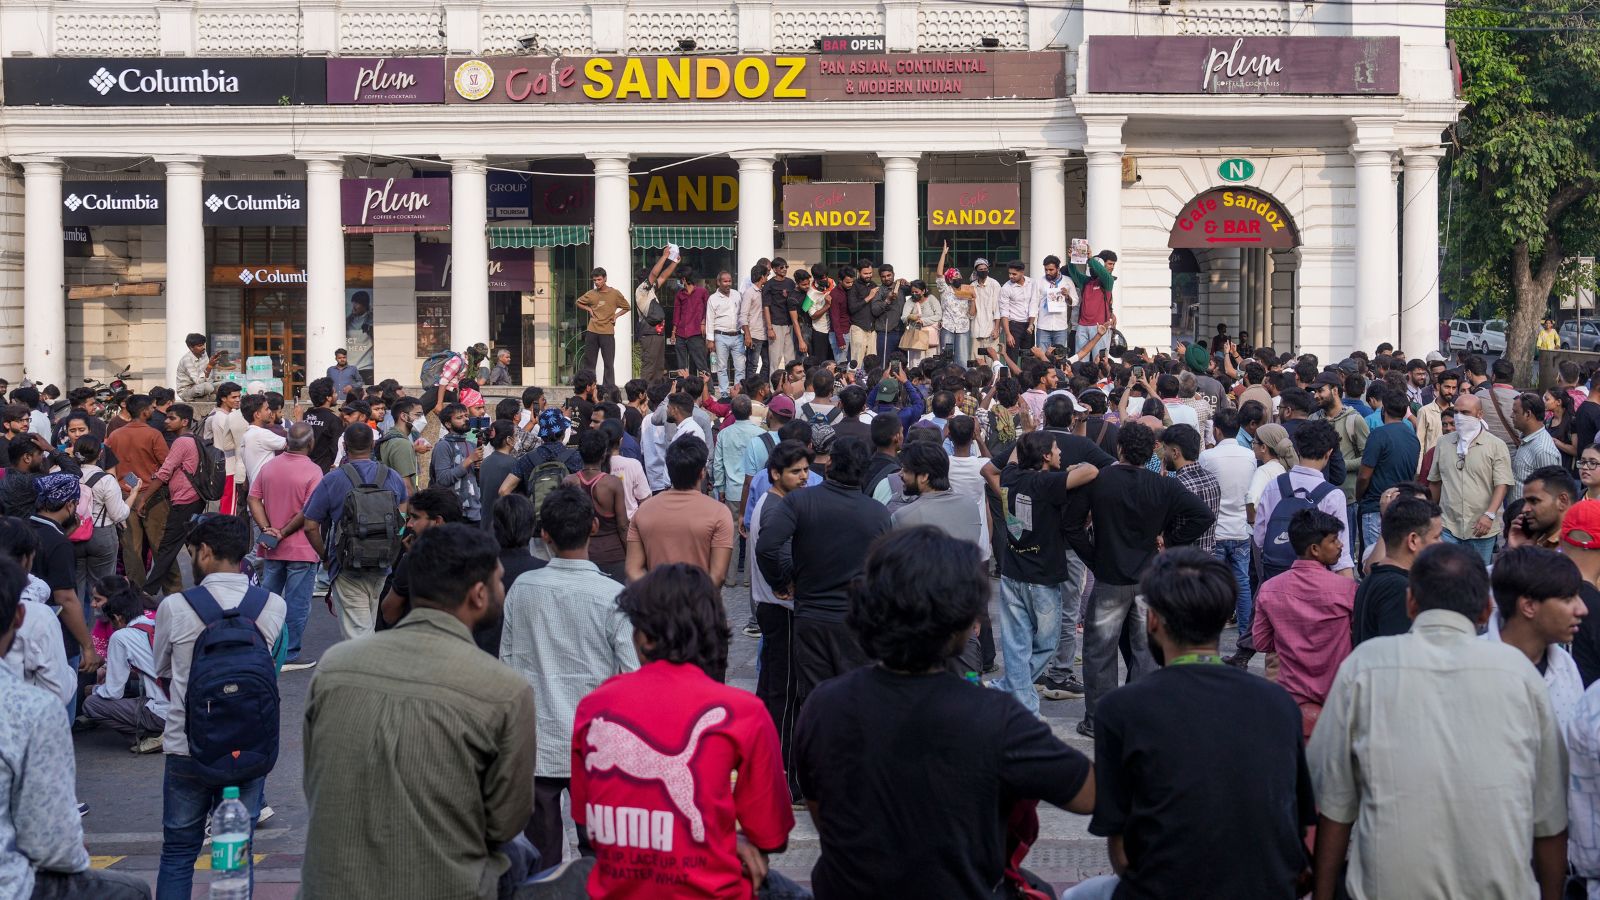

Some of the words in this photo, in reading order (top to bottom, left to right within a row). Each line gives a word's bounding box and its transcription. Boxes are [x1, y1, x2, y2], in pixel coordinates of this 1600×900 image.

[823, 40, 847, 50] BAR
[851, 39, 884, 50] OPEN
[820, 60, 846, 75] PAN
[850, 60, 892, 77] ASIAN,
[896, 58, 987, 74] CONTINENTAL
[1203, 37, 1284, 90] plum
[118, 68, 240, 93] Columbia
[354, 58, 417, 101] plum
[505, 58, 576, 101] Cafe
[582, 57, 807, 99] SANDOZ
[846, 79, 855, 94] &
[858, 79, 913, 94] MODERN
[917, 78, 962, 93] INDIAN
[1229, 161, 1244, 178] N
[489, 183, 527, 193] GROUP
[82, 193, 160, 210] Columbia
[223, 194, 301, 211] Columbia
[361, 177, 431, 225] plum
[787, 210, 871, 227] SANDOZ
[932, 209, 1016, 225] SANDOZ
[1178, 197, 1218, 232] Cafe
[1222, 191, 1285, 233] Sandoz
[63, 227, 88, 242] umbia
[1204, 220, 1219, 234] &
[1223, 219, 1262, 234] BAR
[255, 269, 308, 283] Columb
